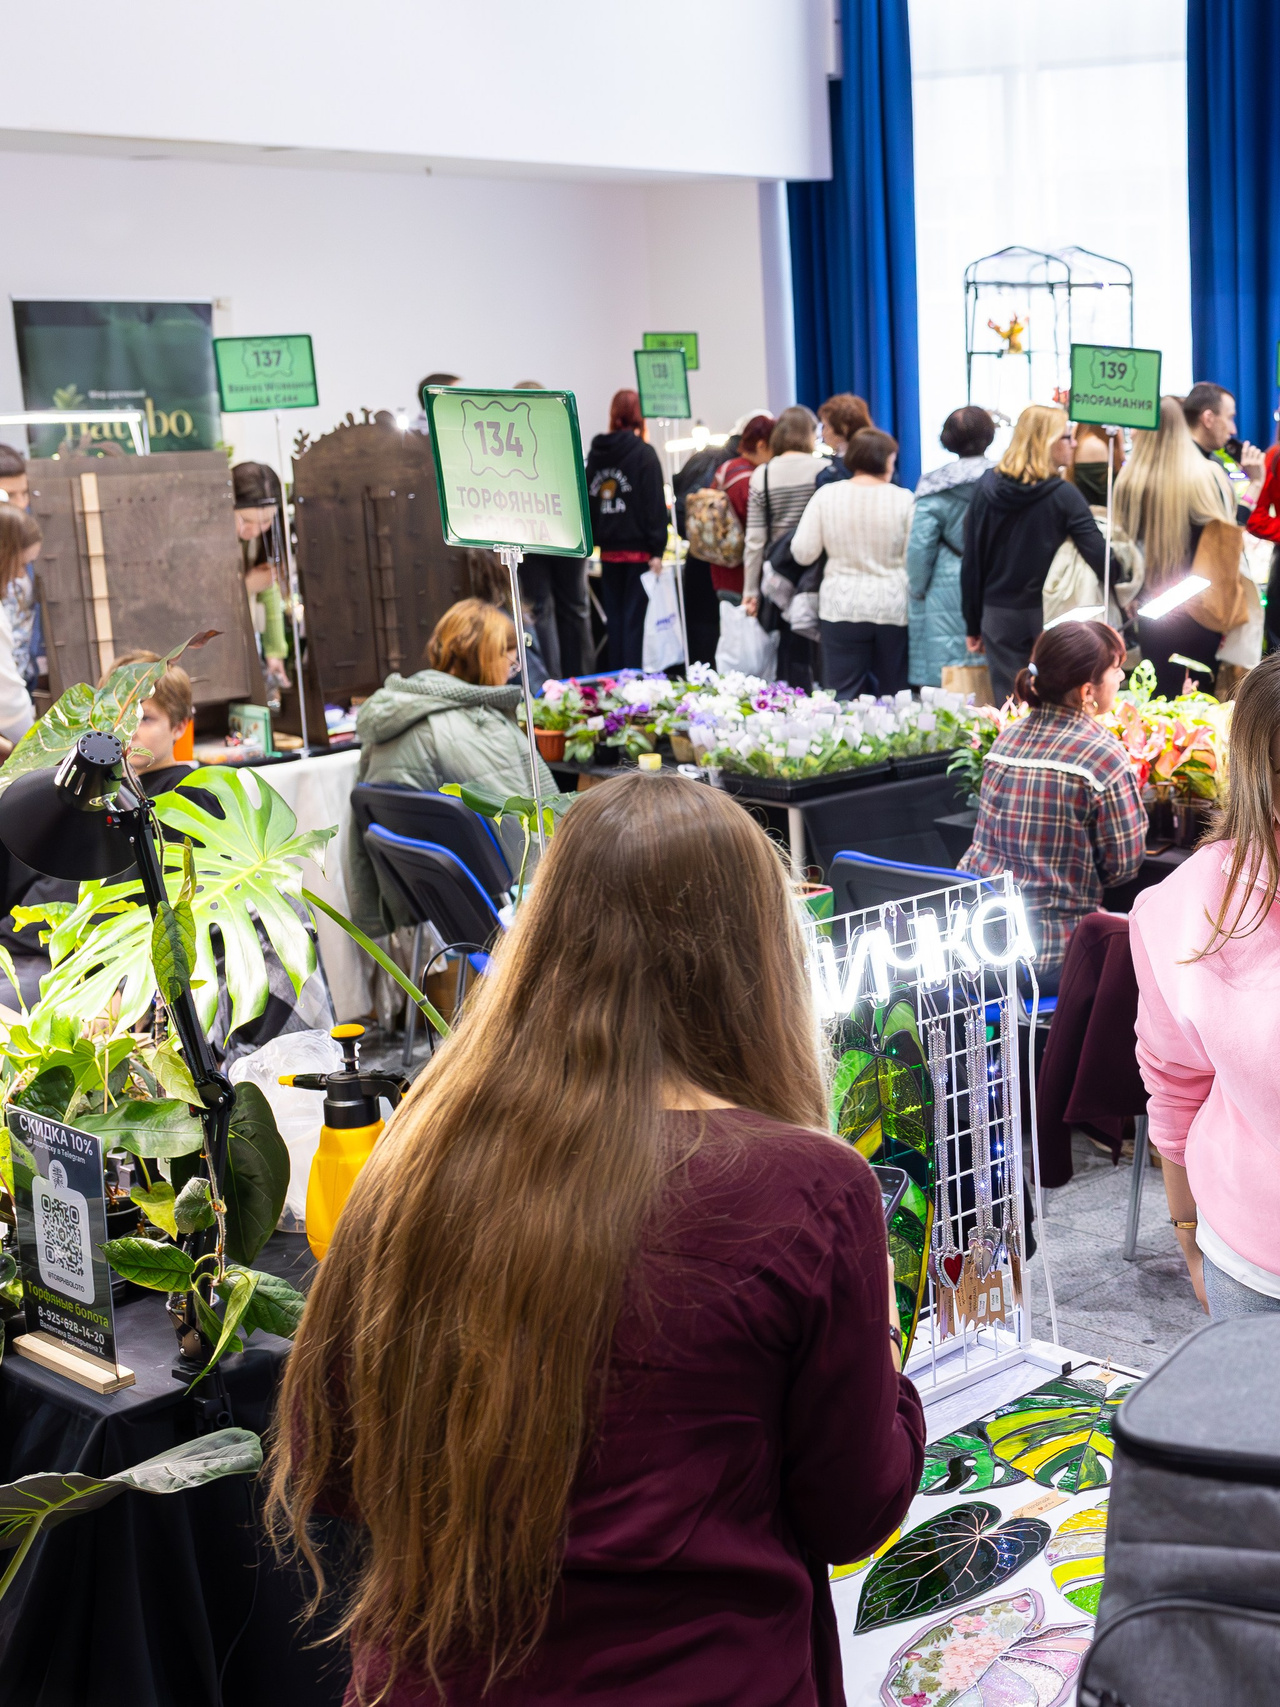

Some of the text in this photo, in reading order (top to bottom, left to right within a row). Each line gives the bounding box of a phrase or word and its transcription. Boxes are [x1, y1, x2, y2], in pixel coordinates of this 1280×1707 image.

[252, 350, 282, 368] 137
[1100, 361, 1127, 379] 139
[1074, 393, 1153, 411] ФЛОРАМАНИЯ
[474, 420, 523, 458] 134
[456, 486, 563, 517] ТОРФЯНЫЕ
[19, 1114, 93, 1156] СКИДКА 10%
[61, 1148, 86, 1164] Telegram
[27, 1280, 109, 1328] Торфяные болота
[37, 1306, 105, 1345] 8-925-628-14-20
